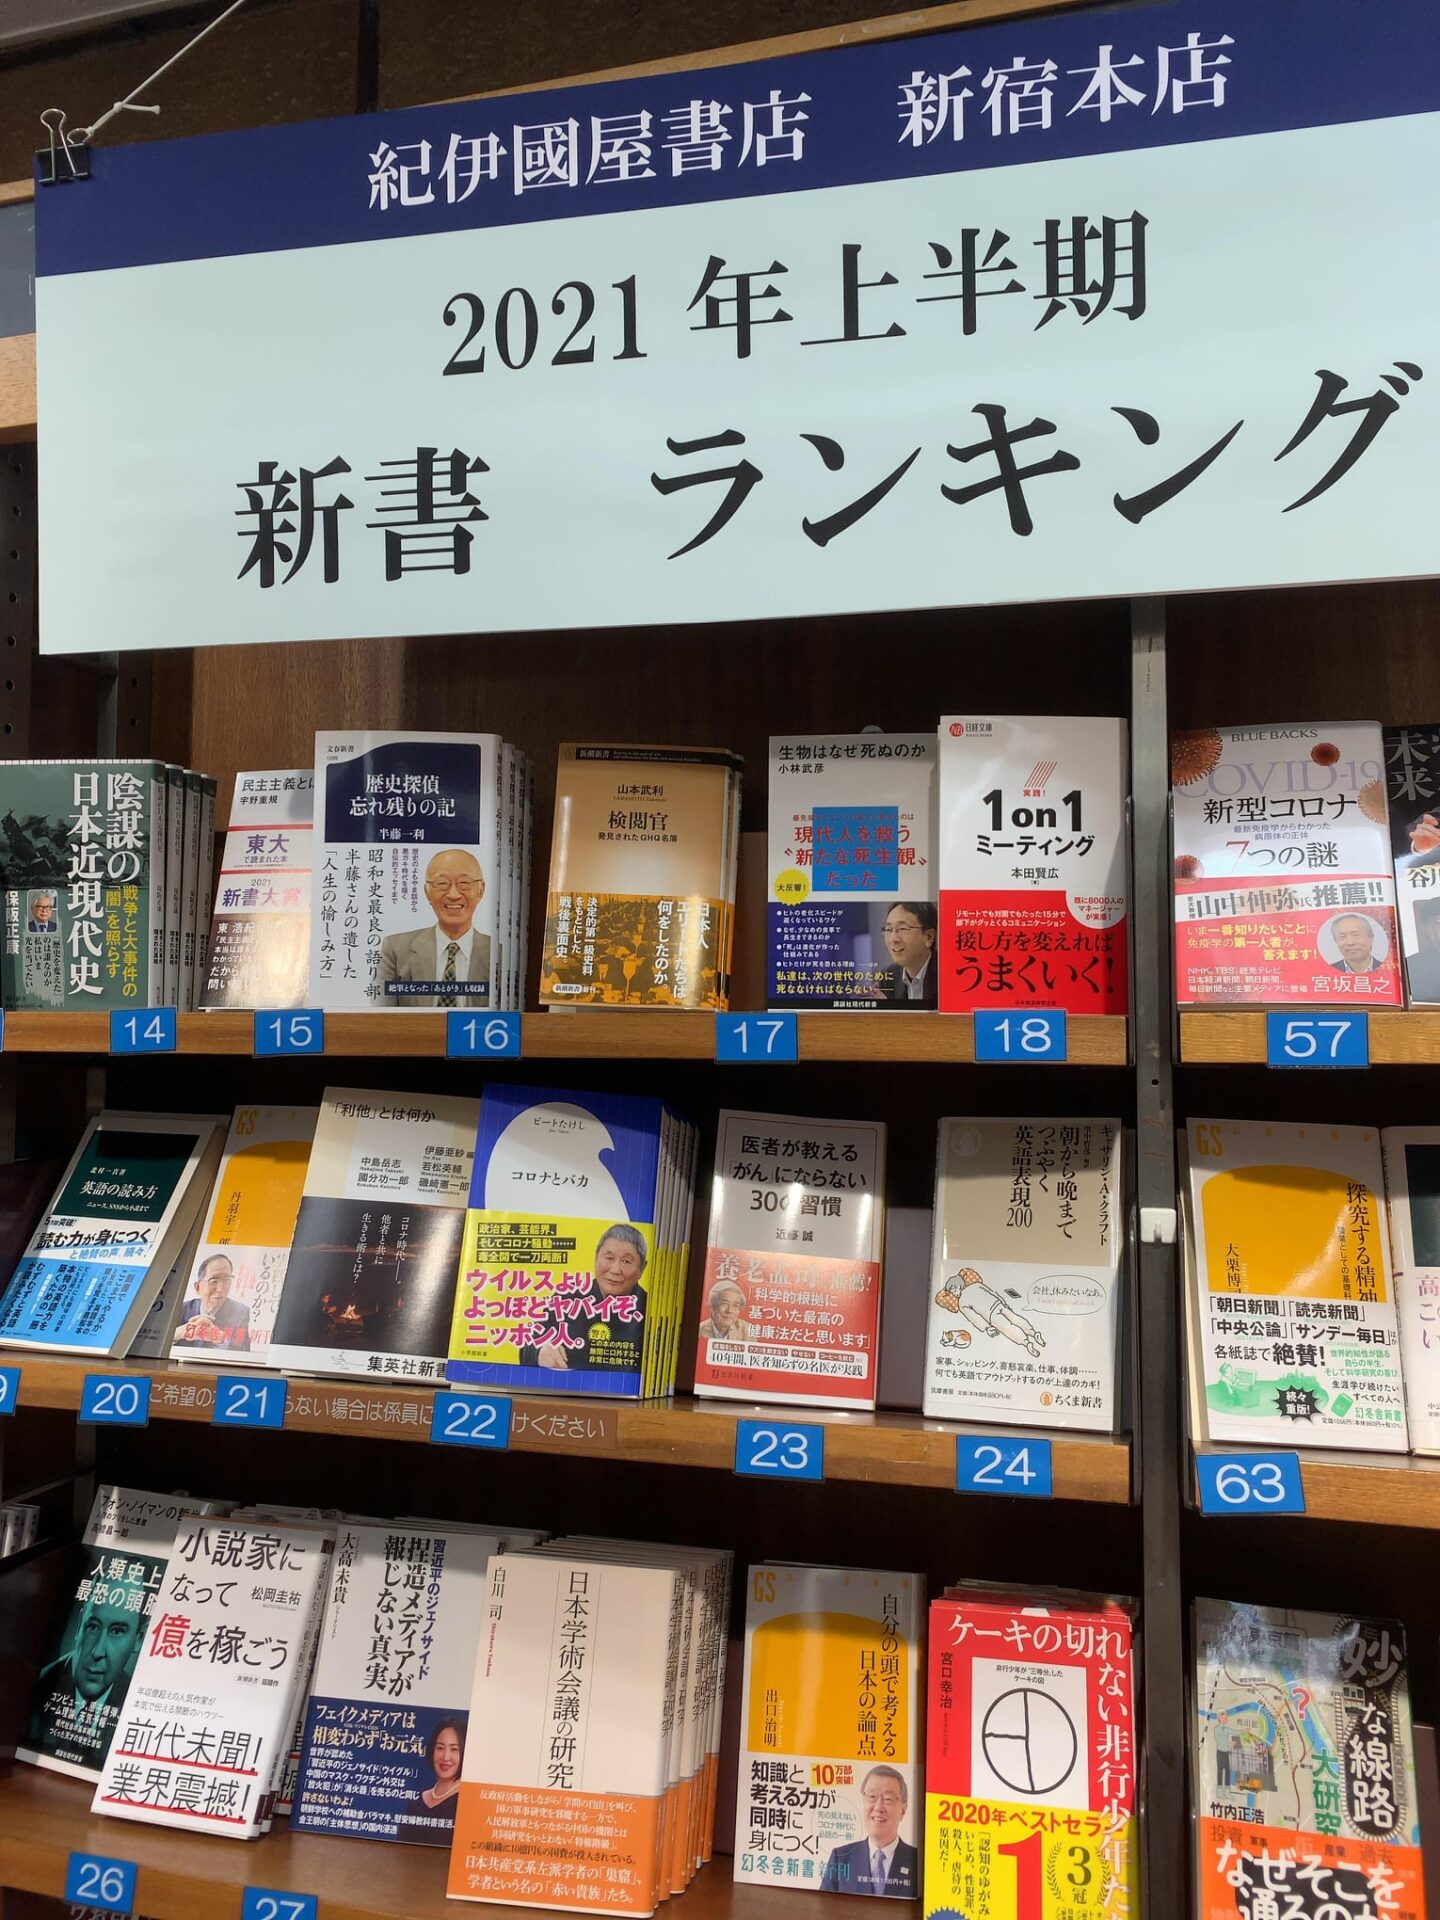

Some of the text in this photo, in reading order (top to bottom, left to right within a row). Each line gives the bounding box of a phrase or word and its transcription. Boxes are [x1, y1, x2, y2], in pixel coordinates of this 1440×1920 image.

[367, 33, 1237, 212] 紀伊國屋書店 新宿本店
[234, 360, 1425, 588] 新書 ランキング
[1231, 730, 1318, 742] BLUE BACKS
[778, 742, 925, 761] 生物はなぜ死ぬのか
[778, 763, 825, 774] 小林武彦
[365, 774, 440, 794] 歴史探偵
[617, 784, 664, 796] 山本武利
[240, 795, 278, 806] 宇野重規
[349, 797, 456, 817] 忘れ残りの記
[1203, 793, 1357, 824] 新型コロナ
[106, 772, 144, 883] 陰謀の
[380, 828, 425, 840] 半藤一利
[608, 811, 669, 831] 検閲官
[794, 825, 910, 843] 現代人を救う
[247, 834, 289, 854] 東大
[976, 834, 1096, 857] ミーティング
[1225, 840, 1340, 874] 7つの謎
[243, 855, 288, 864] で読まれた本
[1011, 867, 1059, 879] 本田賢広
[66, 772, 104, 996] 日本近現代史
[251, 878, 271, 886] 2021
[222, 887, 301, 908] 新書大賞
[5, 890, 20, 955] 保阪正康
[320, 850, 338, 979] 「人生の愉しみ方」
[342, 849, 361, 980] 半藤さんの遺した
[364, 849, 384, 1000] 昭和史最良の語り部
[571, 897, 584, 954] をもとにした
[105, 885, 121, 978] 「闇」を照らす
[122, 885, 139, 997] 戦争と大事件の
[582, 896, 598, 976] 決定的第一級史料
[653, 901, 673, 989] 何をしたのか。
[955, 930, 1115, 951] 接し方を変えれば
[1187, 924, 1316, 936] いま一番知りたいことに
[34, 937, 42, 970] 私はいま
[776, 971, 894, 981] 私達は、次の世代のために
[955, 954, 1115, 994] うまくいく！
[1312, 975, 1393, 995] 宮坂昌之
[124, 1016, 164, 1046] 14
[269, 1016, 312, 1048] 15
[463, 1019, 509, 1050] 16
[733, 1020, 784, 1053] 17
[994, 1018, 1051, 1052] 18
[1284, 1021, 1352, 1058] 57
[335, 1102, 436, 1122] 「利他」とは何か
[533, 1116, 586, 1131] ビートたけし
[425, 1145, 465, 1158] 伊藤亜紗
[741, 1134, 859, 1163] 医者が教える
[1195, 1123, 1223, 1158] GS
[361, 1156, 402, 1168] 中島岳志
[421, 1161, 462, 1174] 若松英輔
[1035, 1126, 1056, 1193] つぶやく
[80, 1180, 159, 1199] 英語の読み方
[358, 1172, 409, 1185] 國分功一郎
[511, 1169, 590, 1189] コロナとバカ
[729, 1161, 868, 1189] 「がん」にならない
[1056, 1125, 1080, 1239] 朝から晩まで
[374, 1214, 392, 1265] 他者と共に
[479, 1223, 555, 1235] 政治家、芸能界、
[478, 1251, 567, 1263] 毒全開で一刀両断！
[1225, 1243, 1243, 1293] 大栗博
[465, 1268, 593, 1293] ウイルスより
[1032, 1285, 1104, 1299] 会社、休みたいなあ。
[463, 1294, 644, 1321] よっぽどヤバイぞ、
[750, 1286, 838, 1308] 「科学的根拠に
[1209, 1296, 1367, 1322] 「朝日新聞」「読売新聞」
[748, 1305, 845, 1327] 基づいた最高の
[464, 1320, 585, 1348] ニッポン人。
[747, 1324, 871, 1349] 健康法だと思います」
[710, 1351, 864, 1377] 10年間、医者知らずの名医が実践
[1214, 1341, 1327, 1369] 各紙誌で絶賛！
[92, 1383, 138, 1415] 20
[225, 1385, 268, 1418] 21
[1285, 1391, 1308, 1402] 続々
[1331, 1380, 1400, 1393] 生涯学び続けたい
[1352, 1392, 1401, 1405] すべての人へ
[149, 1382, 216, 1408] ご希望の
[511, 1410, 606, 1439] けください
[1054, 1395, 1103, 1409] ちくま新書
[1284, 1402, 1311, 1416] 重版！
[444, 1402, 497, 1440] 22
[750, 1430, 808, 1470] 23
[973, 1446, 1036, 1486] 24
[1216, 1463, 1286, 1504] 63
[179, 1527, 305, 1572] 小説家に
[90, 1555, 162, 1588] 人類史上
[332, 1532, 356, 1604] 大高未貴
[169, 1573, 239, 1608] なって
[251, 1586, 302, 1606] 松岡圭祐
[488, 1566, 507, 1621] 白川 司
[753, 1570, 777, 1604] GS
[363, 1534, 407, 1692] 報じない真実
[388, 1536, 432, 1698] 捏造メディアが
[418, 1538, 447, 1681] 習近平のジェノサイド
[149, 1612, 289, 1671] 億を稼ごう
[546, 1570, 591, 1789] 日本学術会議の研究
[880, 1593, 901, 1757] 自分の頭で考える
[940, 1652, 954, 1709] 宮口幸治
[1013, 1674, 1046, 1686] ケーキの図
[316, 1704, 417, 1730] フェイクメディアは
[857, 1649, 878, 1757] 日本の論点
[764, 1689, 779, 1748] 出口治明
[120, 1717, 264, 1775] 前代未聞！
[312, 1724, 427, 1759] 相変わらず「お元気」
[751, 1760, 805, 1784] 知識と
[812, 1764, 835, 1786] 10
[105, 1762, 249, 1823] 業界震撼！
[301, 1791, 354, 1807] 許さないわよ！
[750, 1783, 837, 1810] 考える力が
[1096, 1661, 1132, 1920] ない非行少年た
[750, 1806, 804, 1830] 同時に
[1210, 1801, 1266, 1825] 竹内正浩
[748, 1829, 820, 1856] 身につく！
[939, 1827, 950, 1872] 原因だ！
[76, 1862, 125, 1902] 26
[465, 1855, 642, 1886] 日本共産党系左派学者の「巣窟」、
[741, 1853, 815, 1878] 幻冬舎新書
[818, 1860, 851, 1881] 新刊
[998, 1830, 1043, 1920] 1
[1215, 1838, 1406, 1909] なぜそこを
[467, 1873, 635, 1904] 学者という名の「赤い貴族」たち。
[256, 1897, 306, 1920] 27
